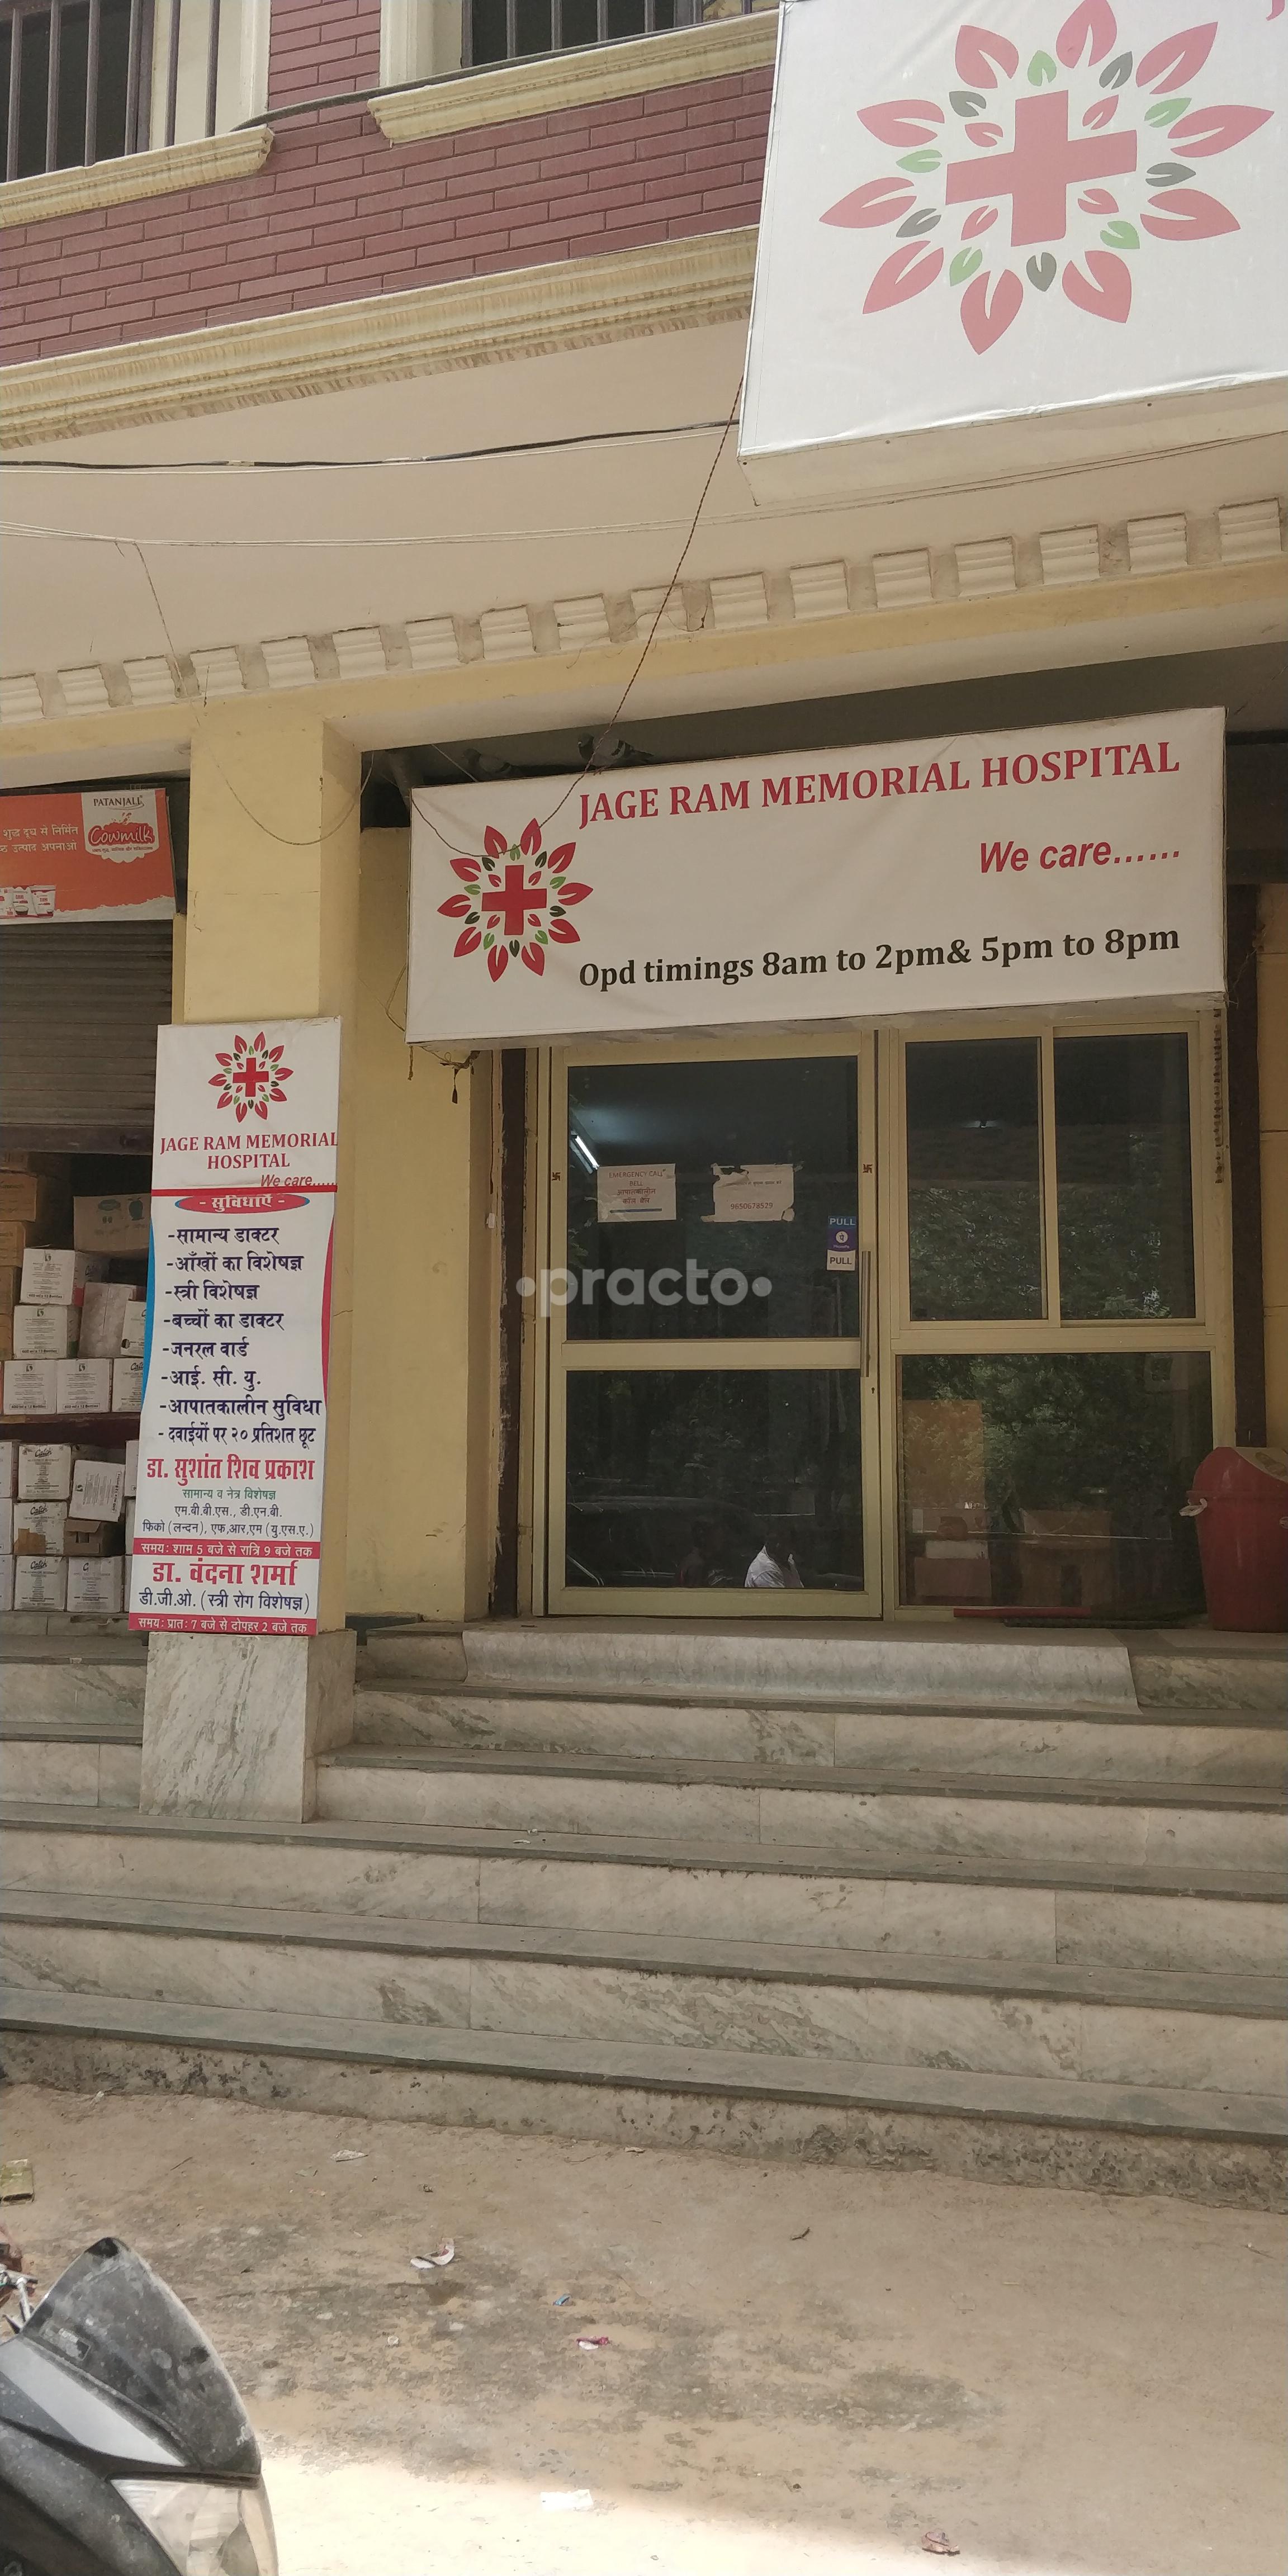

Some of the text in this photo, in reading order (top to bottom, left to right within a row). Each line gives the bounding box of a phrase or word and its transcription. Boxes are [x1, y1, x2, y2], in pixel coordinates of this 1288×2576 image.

[579, 741, 1180, 830] JAGE RAM MEMORIAL HOSPITAL
[93, 796, 143, 808] PATANJALI
[3, 823, 78, 840] शुद्ध दूध से निर्मित
[90, 827, 153, 844] Cowmilk
[12, 843, 36, 853] उत्पाद
[41, 839, 77, 851] अपनाओ
[980, 840, 1029, 874] We
[579, 959, 636, 992] Opd
[644, 955, 754, 985] timings
[762, 950, 827, 976] 8am
[836, 949, 866, 972] to
[981, 936, 1053, 968] 5pm
[1063, 932, 1095, 956] to
[1105, 928, 1180, 957] 8pm
[160, 1132, 338, 1154] JAGE RAM MEMORIAL
[207, 1153, 290, 1169] HOSPITAL
[261, 1175, 280, 1187] We
[617, 1187, 656, 1196] आपातकालीन
[234, 1228, 280, 1245] डाक्टर
[222, 1257, 243, 1272] का
[247, 1251, 305, 1271] विशेषज्ञ
[203, 1279, 261, 1300] विशेषज्ञ
[214, 1314, 235, 1329] का
[239, 1313, 285, 1330] डाक्टर
[220, 1336, 250, 1358] वार्ड
[272, 1394, 323, 1421] सुविधा
[169, 1422, 210, 1446] दवाईयों
[213, 1428, 228, 1446] पर
[231, 1429, 249, 1442] २०
[252, 1422, 296, 1444] प्रतिशत
[299, 1428, 316, 1450] छूट
[146, 1453, 315, 1486] डा. सुशांत शिव प्रकाश
[182, 1486, 277, 1500] सामान्य व नेत्र विशेषज्ञ
[172, 1544, 193, 1554] शाम
[197, 1544, 203, 1555] 5
[207, 1541, 224, 1555] बजे
[226, 1541, 236, 1556] से
[240, 1542, 260, 1556] रात्रि
[264, 1546, 271, 1556] 9
[274, 1543, 292, 1557] बजे
[295, 1547, 313, 1557] तक
[152, 1557, 299, 1587] डा. वंदना शर्मा
[233, 1590, 254, 1609] रोग
[191, 1620, 197, 1630] 7
[200, 1617, 216, 1631] बजे
[219, 1617, 228, 1631] से
[231, 1617, 259, 1632] दोपहर
[262, 1621, 268, 1632] 2
[272, 1619, 288, 1633] बजे
[290, 1623, 308, 1633] तक
